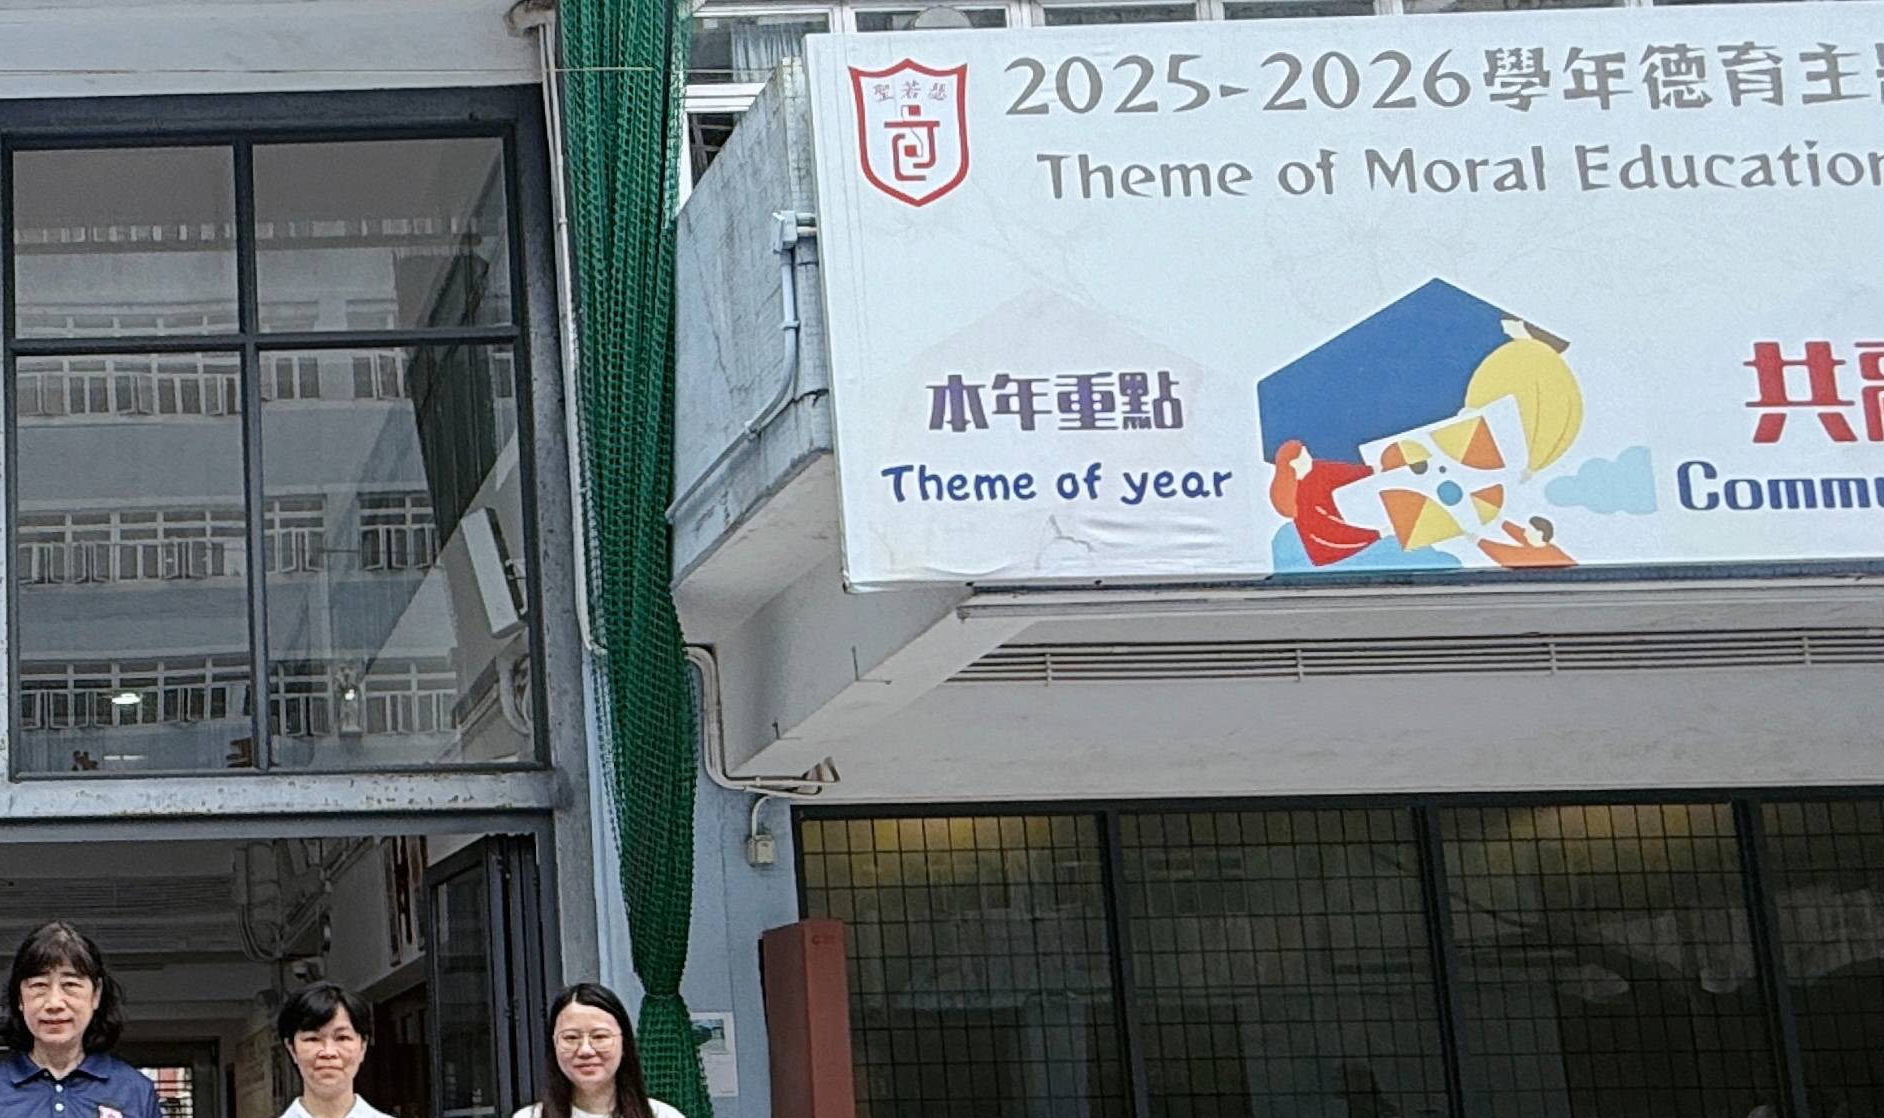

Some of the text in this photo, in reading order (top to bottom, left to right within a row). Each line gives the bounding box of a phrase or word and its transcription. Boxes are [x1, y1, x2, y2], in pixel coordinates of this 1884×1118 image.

[1003, 41, 1884, 116] 2025-2026學年德育主
[1037, 153, 1253, 200] Theme
[1278, 148, 1339, 197] of
[1365, 144, 1546, 194] Moral
[925, 371, 1184, 433] 本年重點
[1742, 341, 1884, 443] 共
[881, 462, 1233, 505] Theme of year
[1676, 460, 1884, 511] Comm
